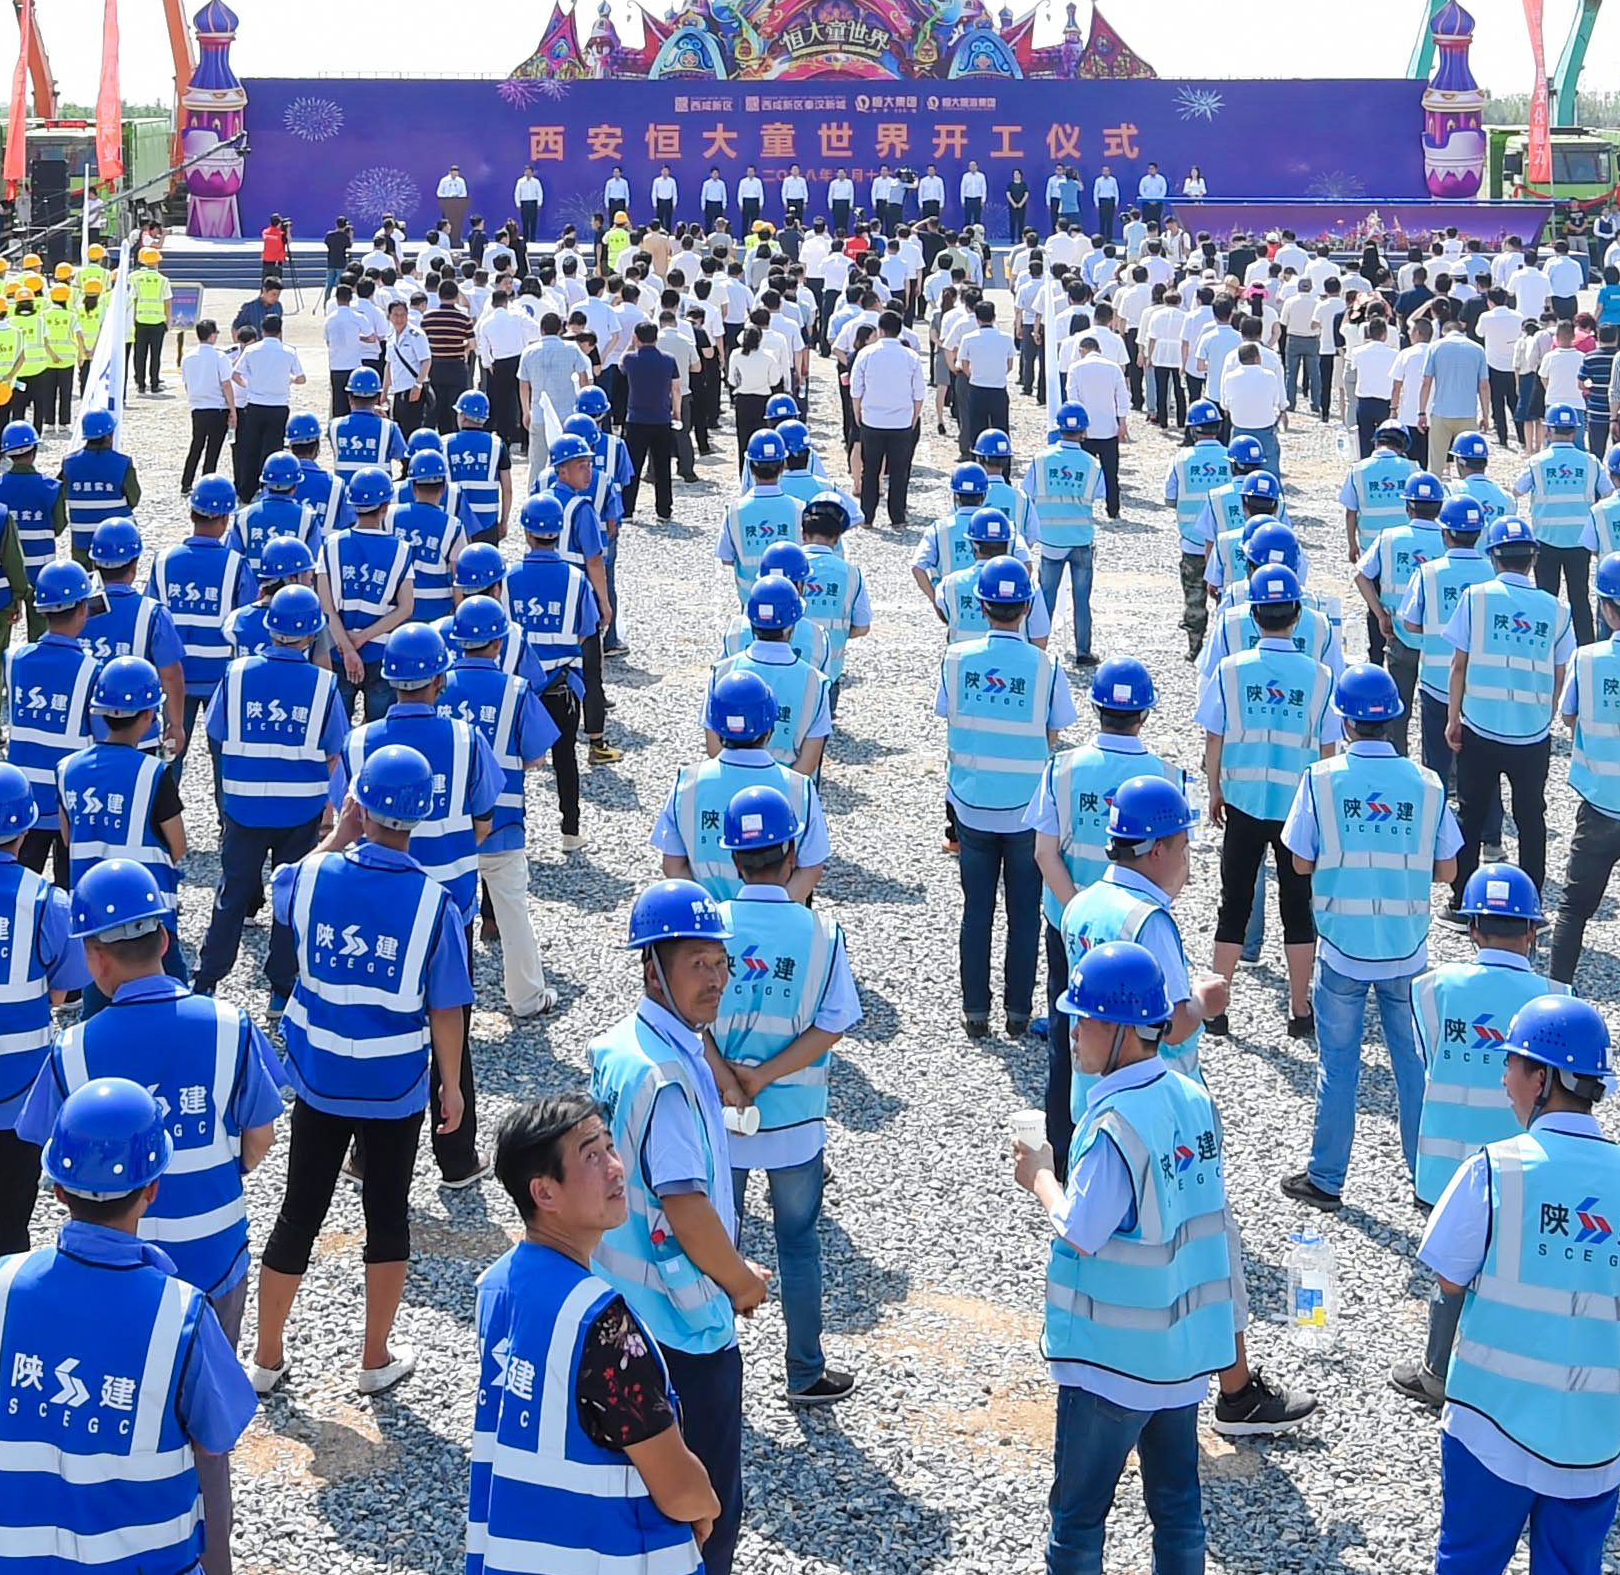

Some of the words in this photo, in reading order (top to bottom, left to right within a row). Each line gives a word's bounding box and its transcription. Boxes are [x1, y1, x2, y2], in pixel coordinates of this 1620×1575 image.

[782, 19, 890, 50] 恒大童世界
[529, 122, 1140, 161] 西安恒大童世界开工仪式
[1495, 613, 1549, 637] 陕建
[966, 670, 1025, 694] 陕建
[1247, 680, 1303, 705] 陕建
[246, 698, 308, 722] 陕建
[1344, 793, 1414, 823] 陕建
[316, 925, 398, 961] 陕建
[315, 953, 396, 977] SCEGC
[11, 1352, 136, 1412] 陕建
[9, 1397, 130, 1434] SCEGC
